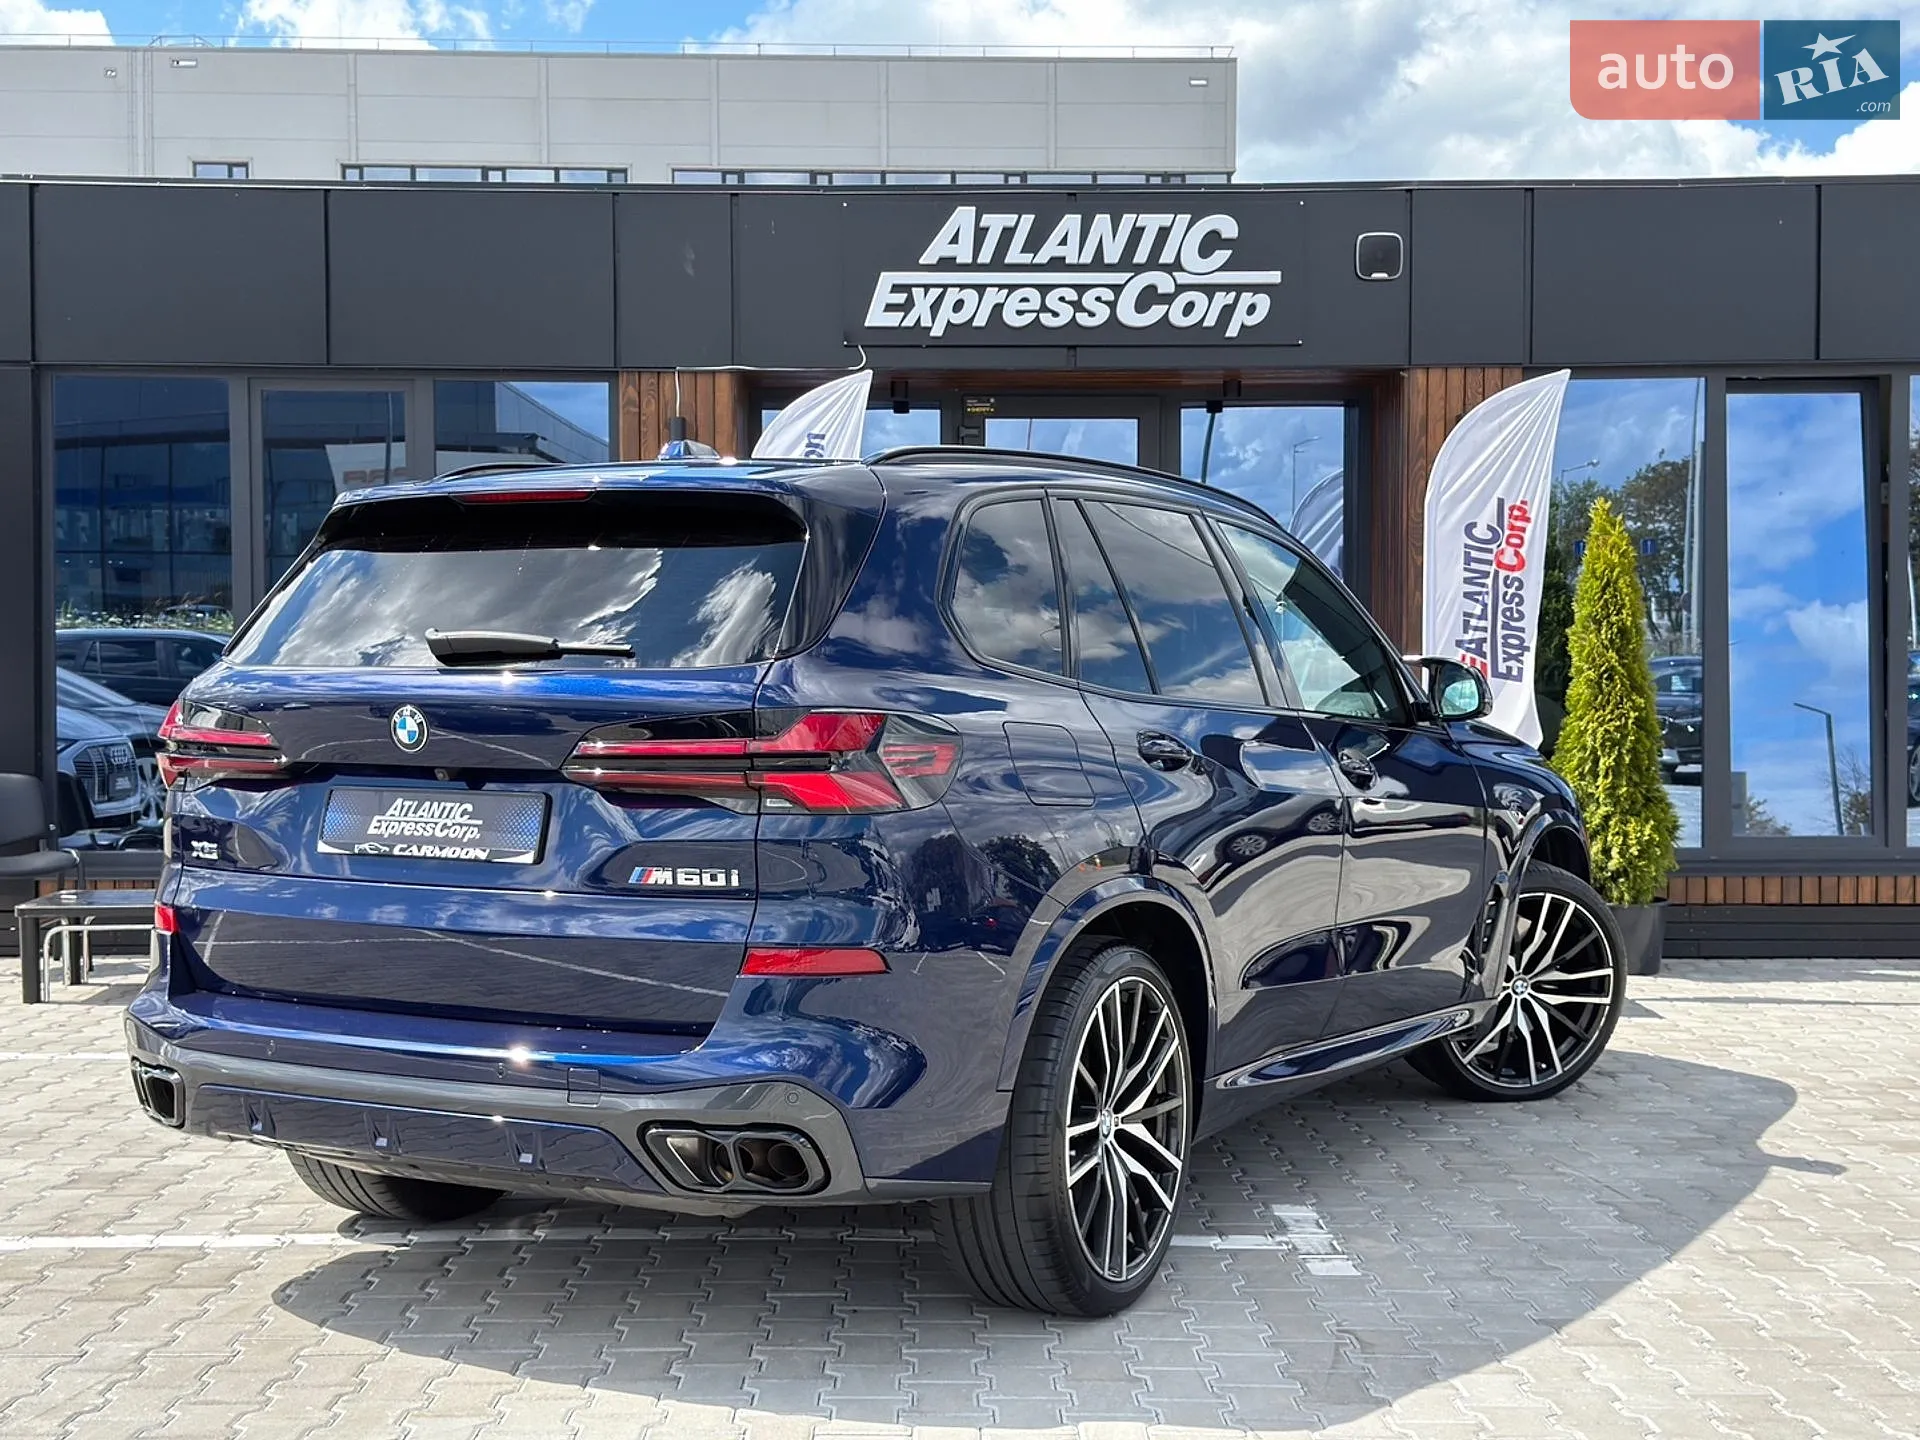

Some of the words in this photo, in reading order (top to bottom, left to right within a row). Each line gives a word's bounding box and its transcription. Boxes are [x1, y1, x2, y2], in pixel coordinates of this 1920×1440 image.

[918, 206, 1239, 274] ATLANTIC
[864, 271, 1271, 338] ExpressCorp
[1455, 521, 1501, 660] ATLANTIC
[386, 798, 473, 821] ATLANTIC
[393, 843, 491, 860] CARMOON
